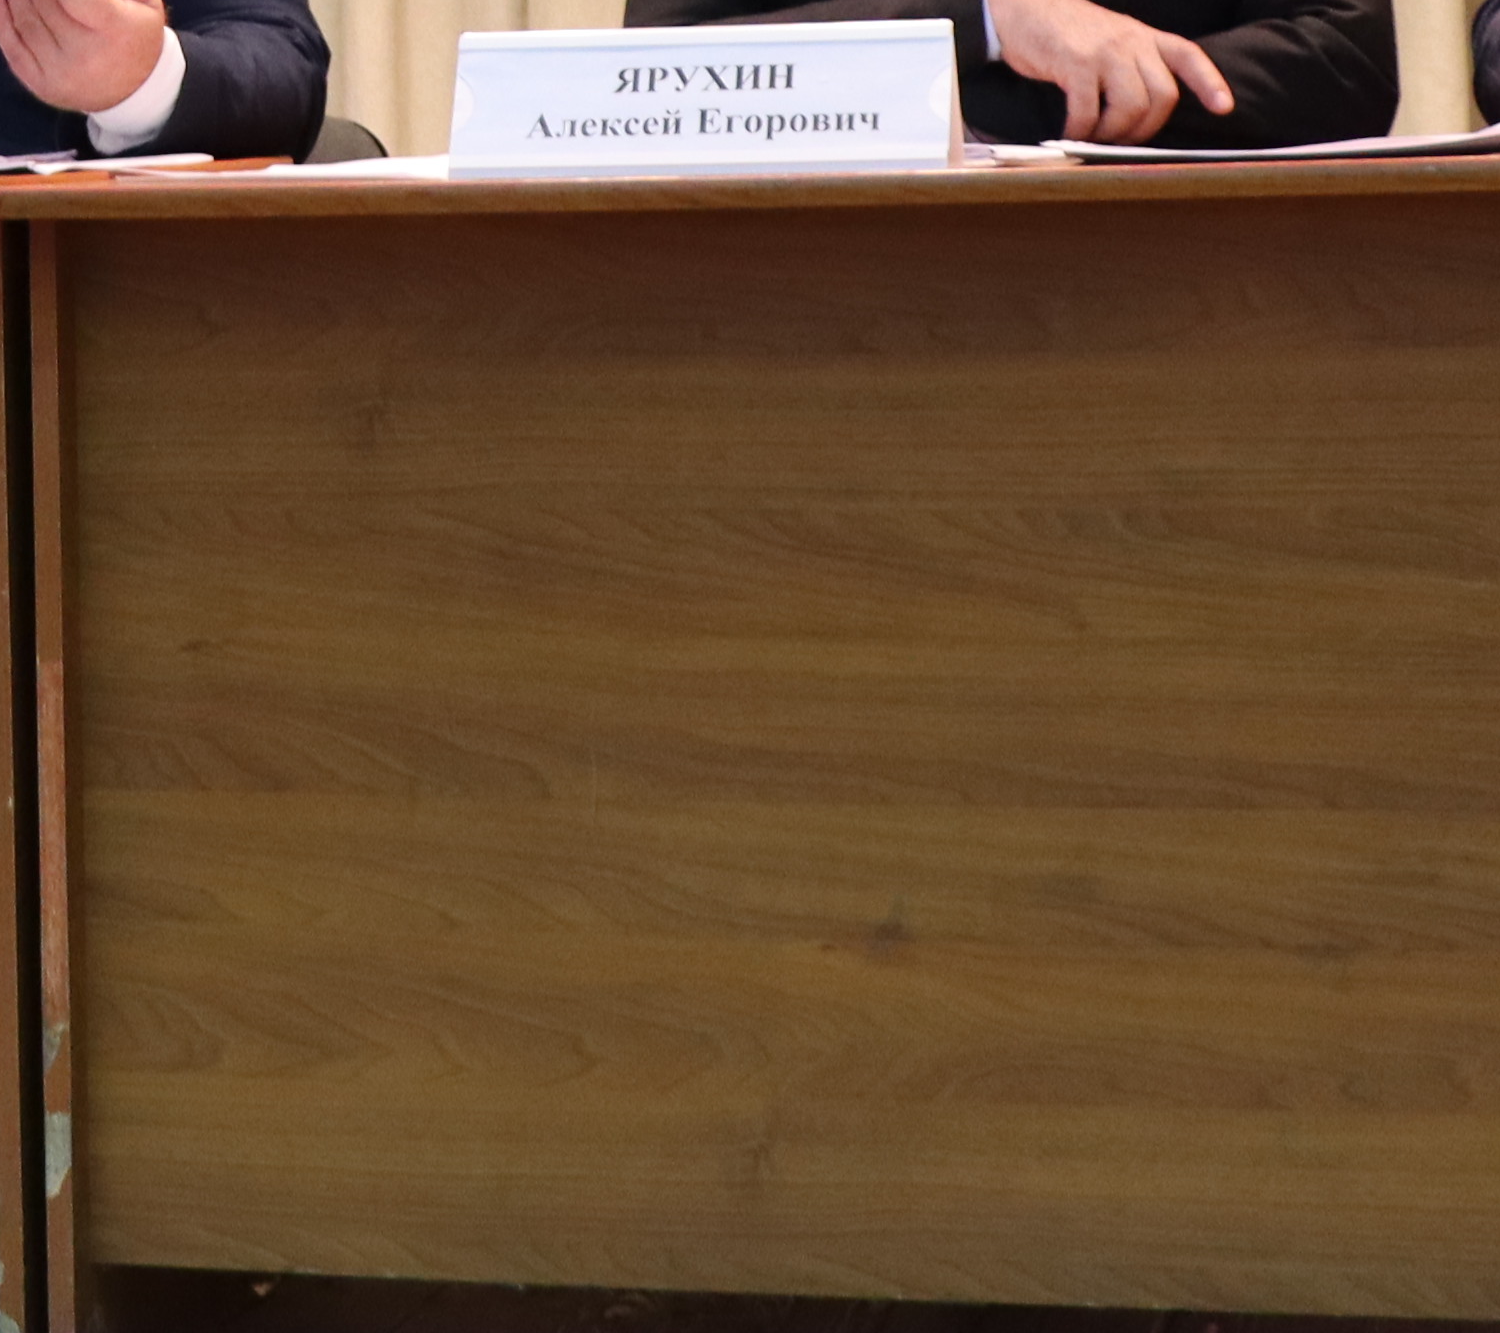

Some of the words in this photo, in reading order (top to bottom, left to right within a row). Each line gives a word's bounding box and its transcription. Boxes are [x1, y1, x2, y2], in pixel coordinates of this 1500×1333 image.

[614, 63, 796, 93] ЯРУХИН
[527, 109, 682, 138] Алексей
[698, 107, 880, 140] Егорович
